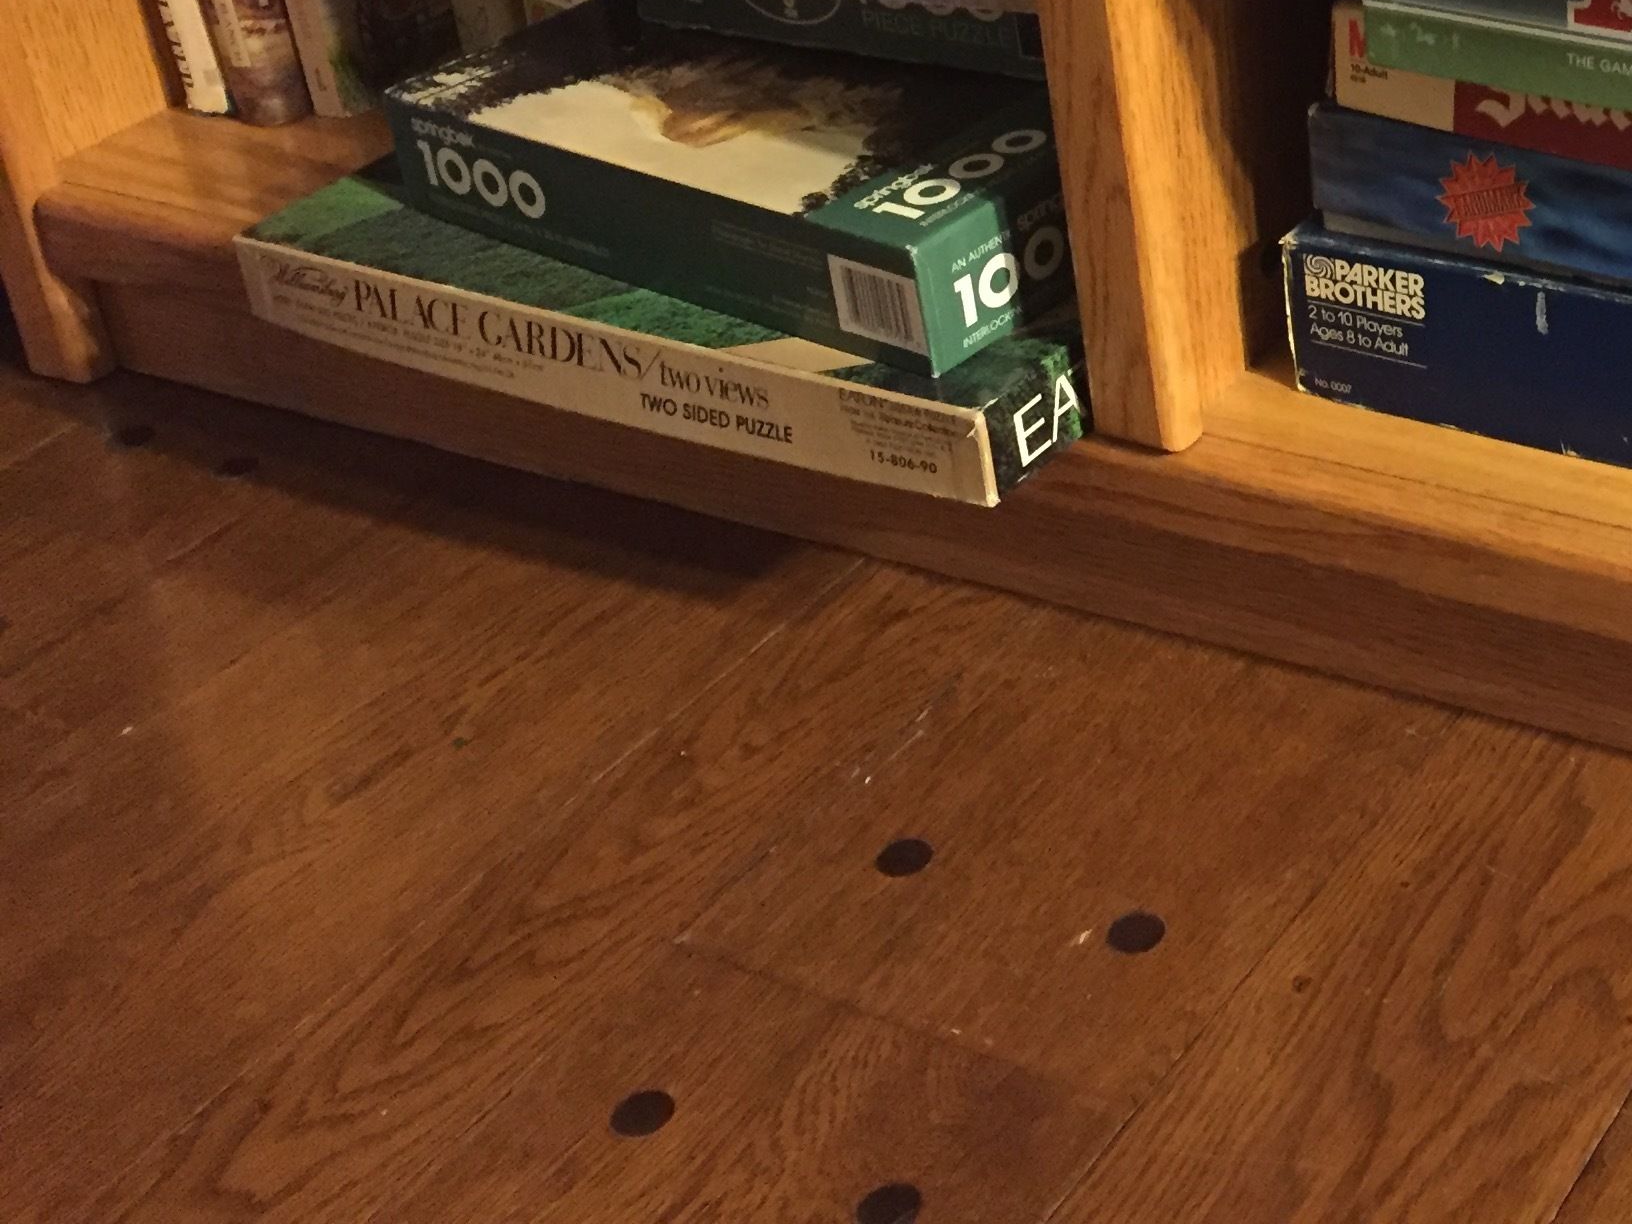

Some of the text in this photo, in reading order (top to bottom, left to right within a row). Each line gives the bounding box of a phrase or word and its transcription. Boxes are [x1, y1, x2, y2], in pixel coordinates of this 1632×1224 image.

[860, 9, 1016, 51] PIECE PUZZLE
[1567, 53, 1596, 74] THE
[416, 138, 547, 220] 1000
[871, 127, 1048, 220] 1000
[951, 256, 968, 274] AN
[1333, 259, 1426, 298] PARKER
[1304, 276, 1427, 320] BROTHERS
[1307, 305, 1404, 338] 2 to 10 Players
[1309, 323, 1409, 357] Ages 8 to Adult
[353, 278, 472, 340] PALACE
[660, 359, 701, 395] two
[705, 366, 770, 410] views
[638, 392, 794, 445] TWO SIDED PUZZLE
[869, 448, 938, 474] 15-806-90
